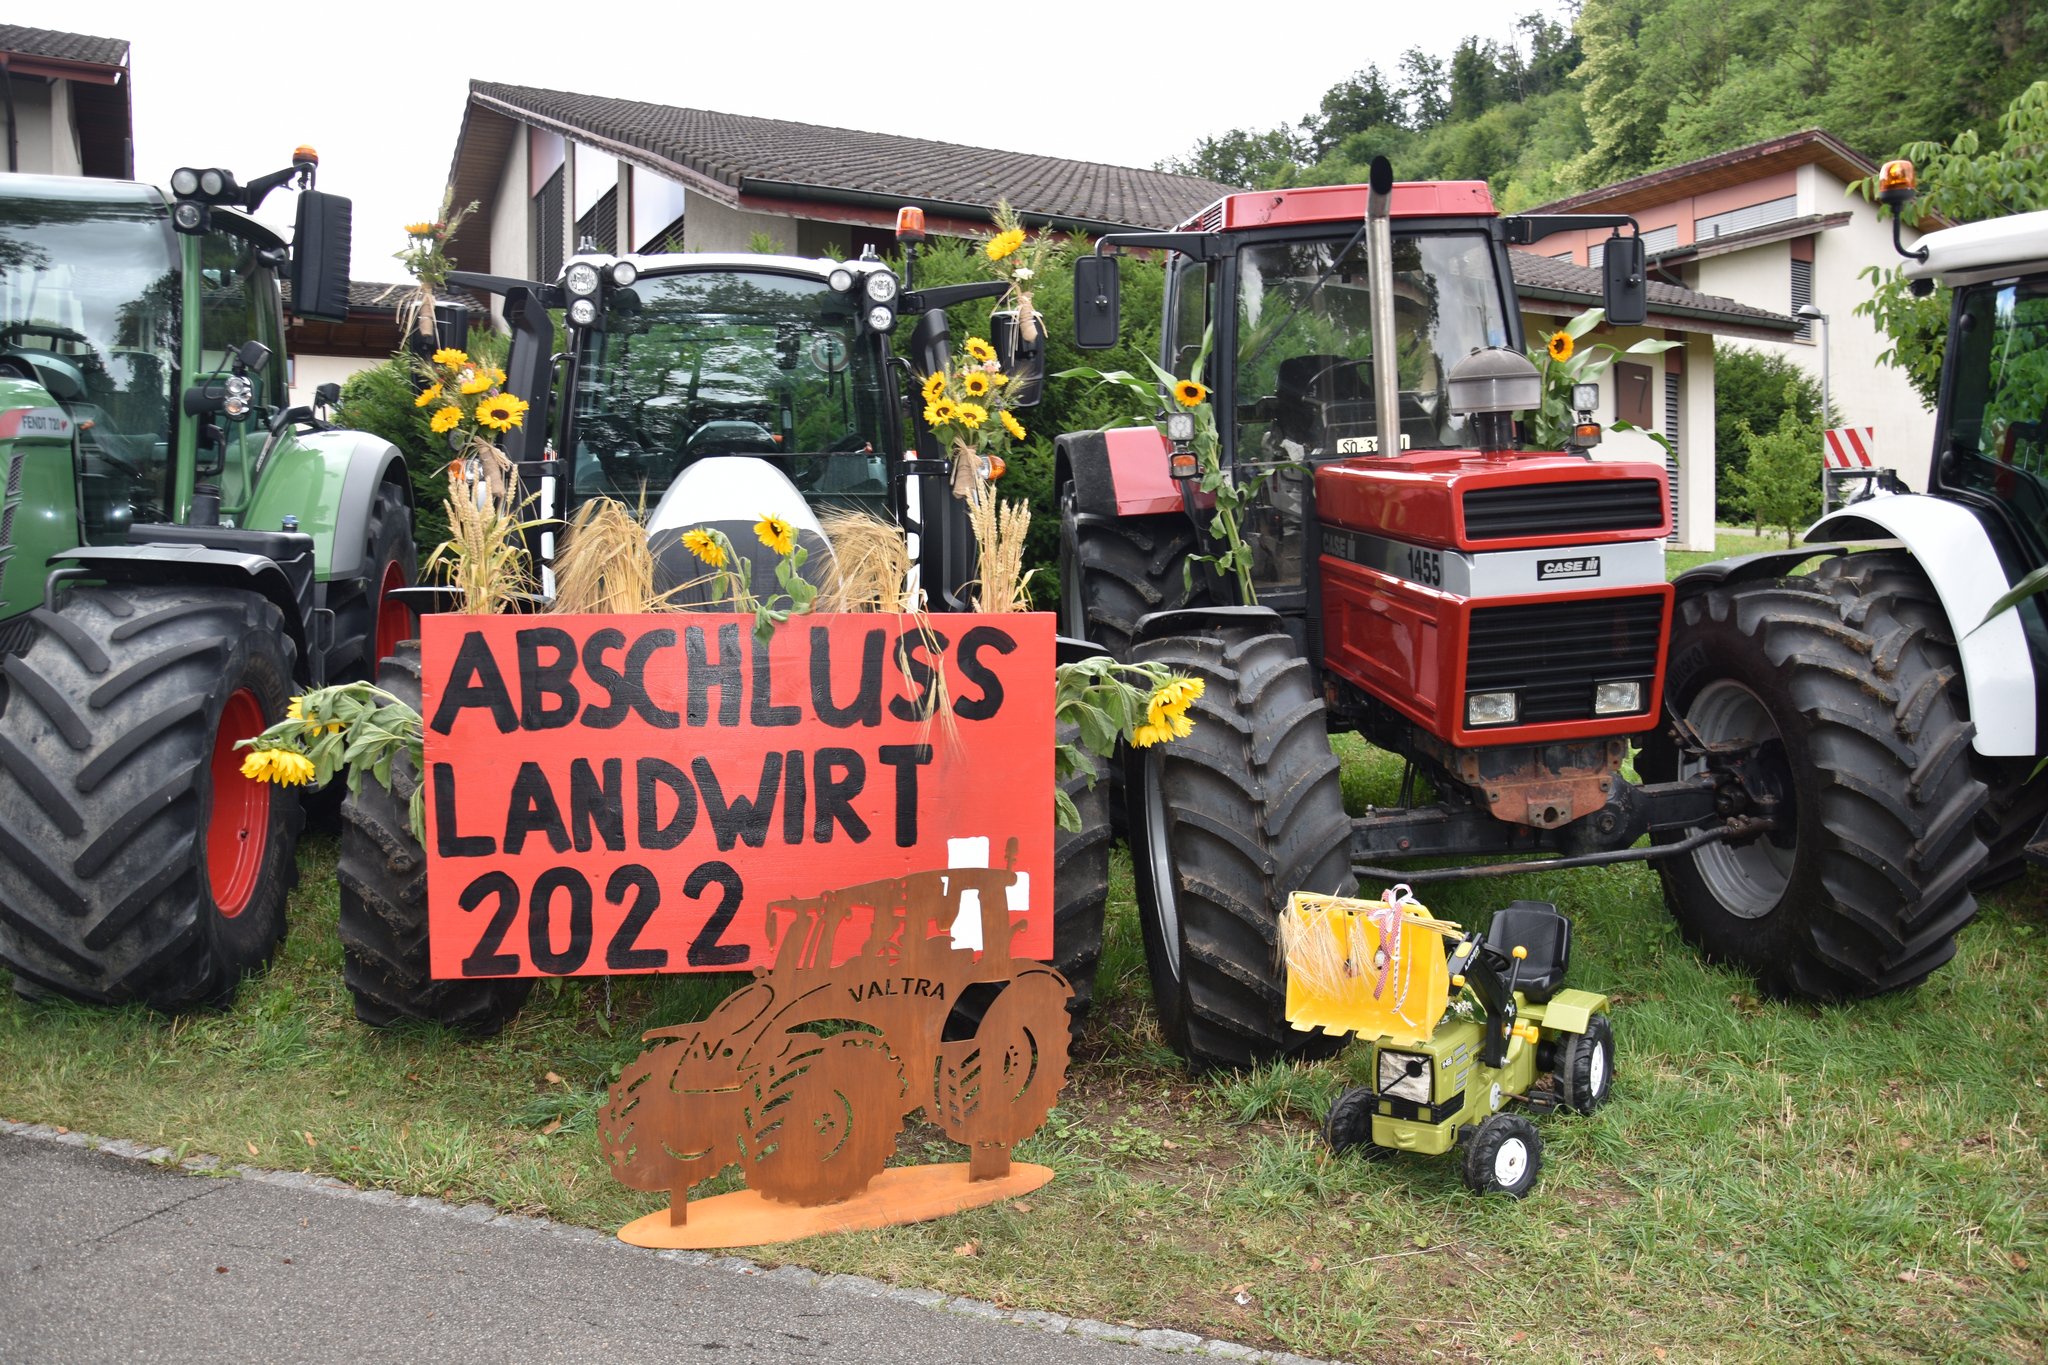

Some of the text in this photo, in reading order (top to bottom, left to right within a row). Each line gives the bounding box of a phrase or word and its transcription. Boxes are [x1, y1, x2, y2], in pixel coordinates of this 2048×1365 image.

[22, 415, 47, 430] FENDT
[1322, 532, 1346, 559] CASE
[1408, 547, 1441, 587] 1455
[1543, 561, 1583, 573] CASE
[430, 623, 1018, 735] ABSCHLUSS
[433, 744, 934, 857] LANDWIRT
[459, 861, 750, 976] 2022
[848, 977, 945, 1003] VALTRA
